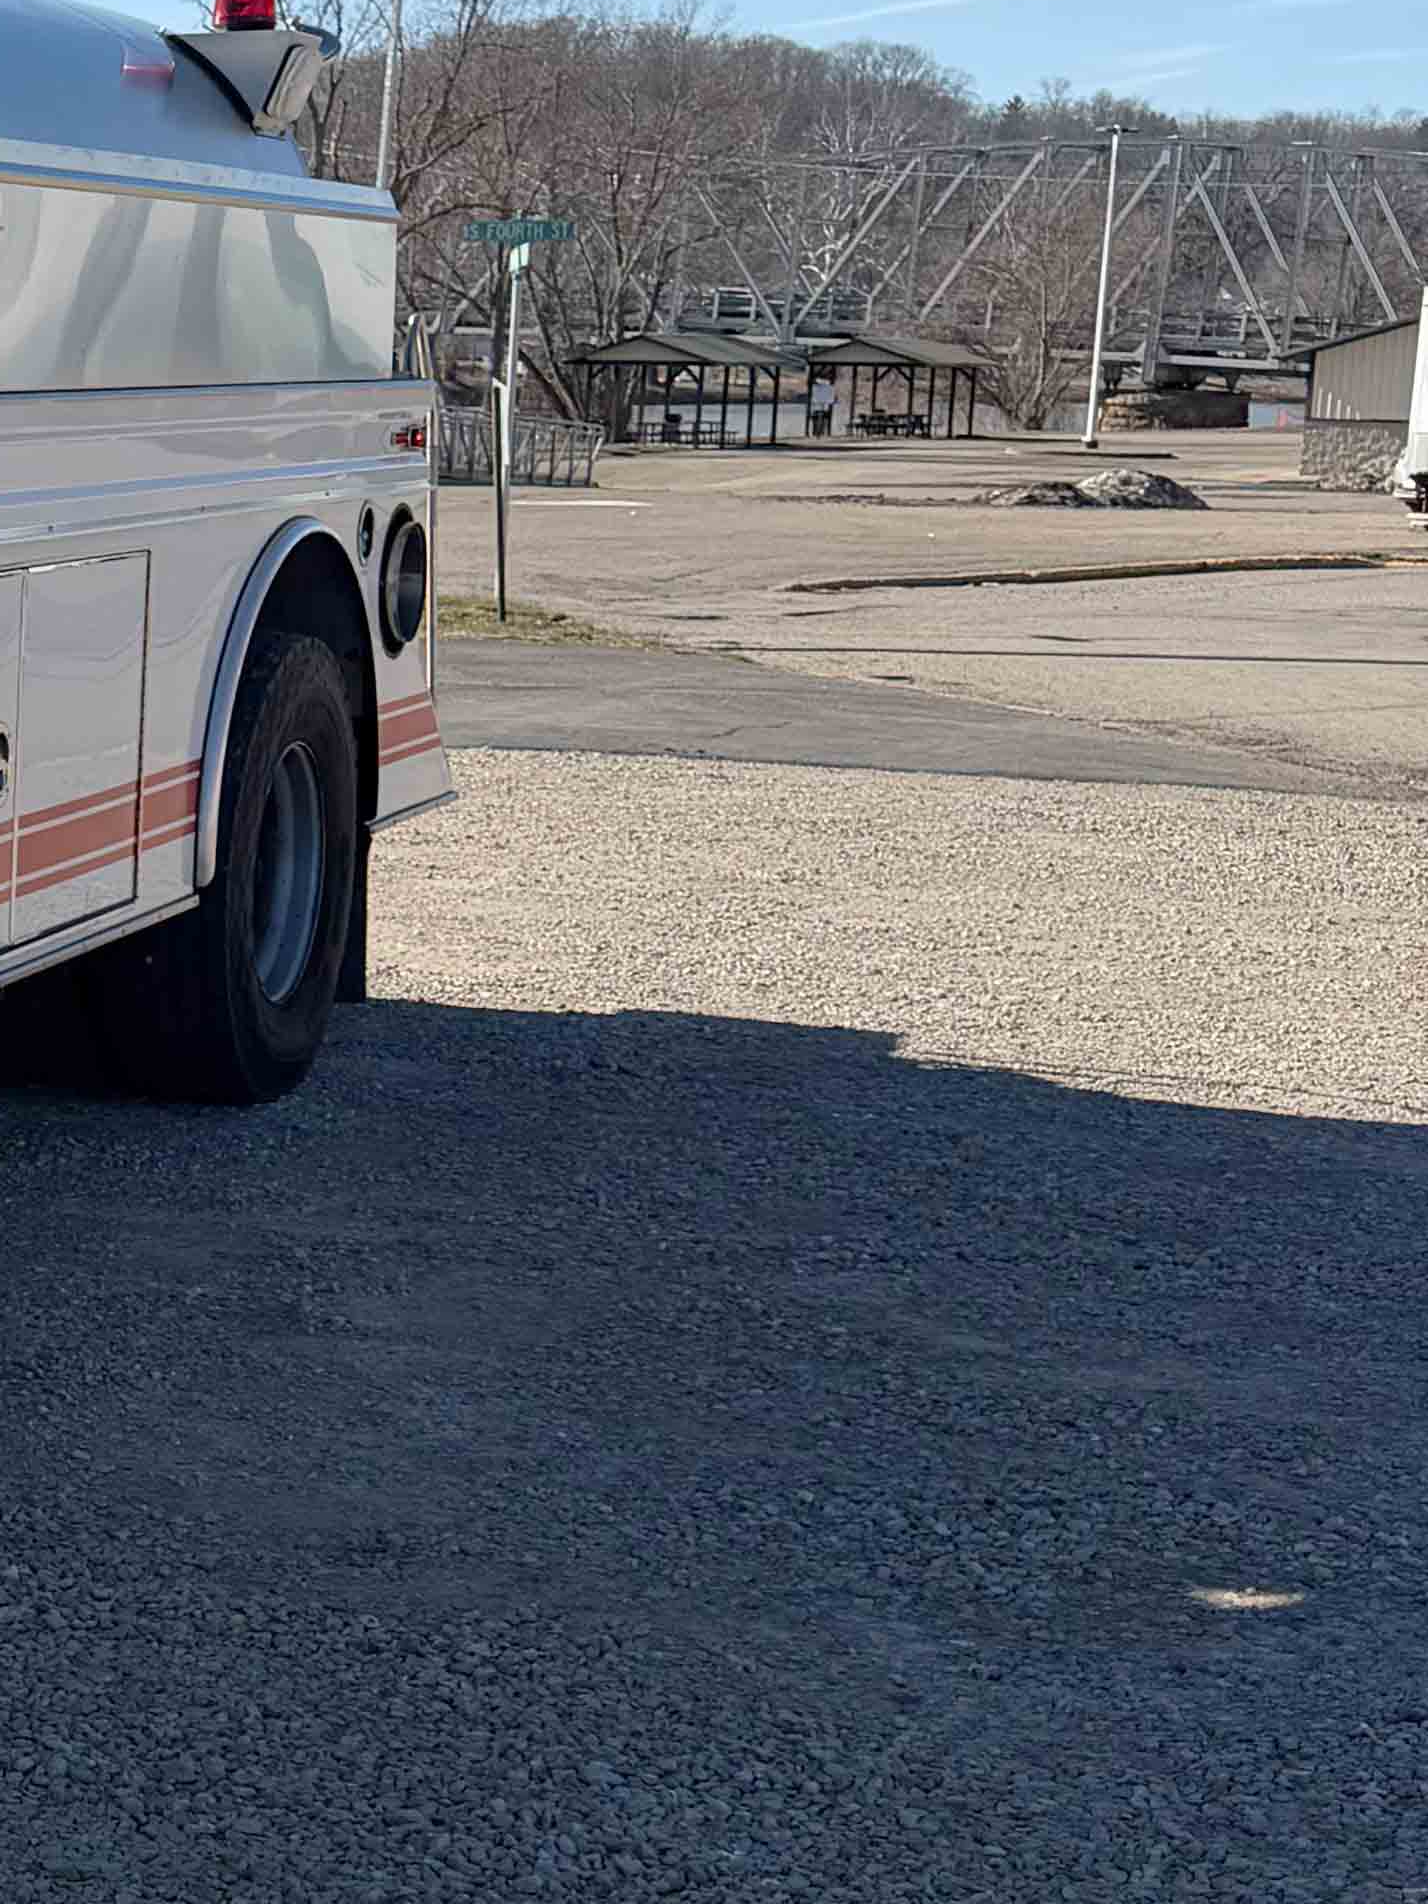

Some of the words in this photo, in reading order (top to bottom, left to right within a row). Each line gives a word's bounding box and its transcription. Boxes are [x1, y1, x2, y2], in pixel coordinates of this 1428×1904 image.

[470, 224, 481, 239] S
[487, 223, 544, 239] FOURTH
[551, 223, 568, 239] ST
